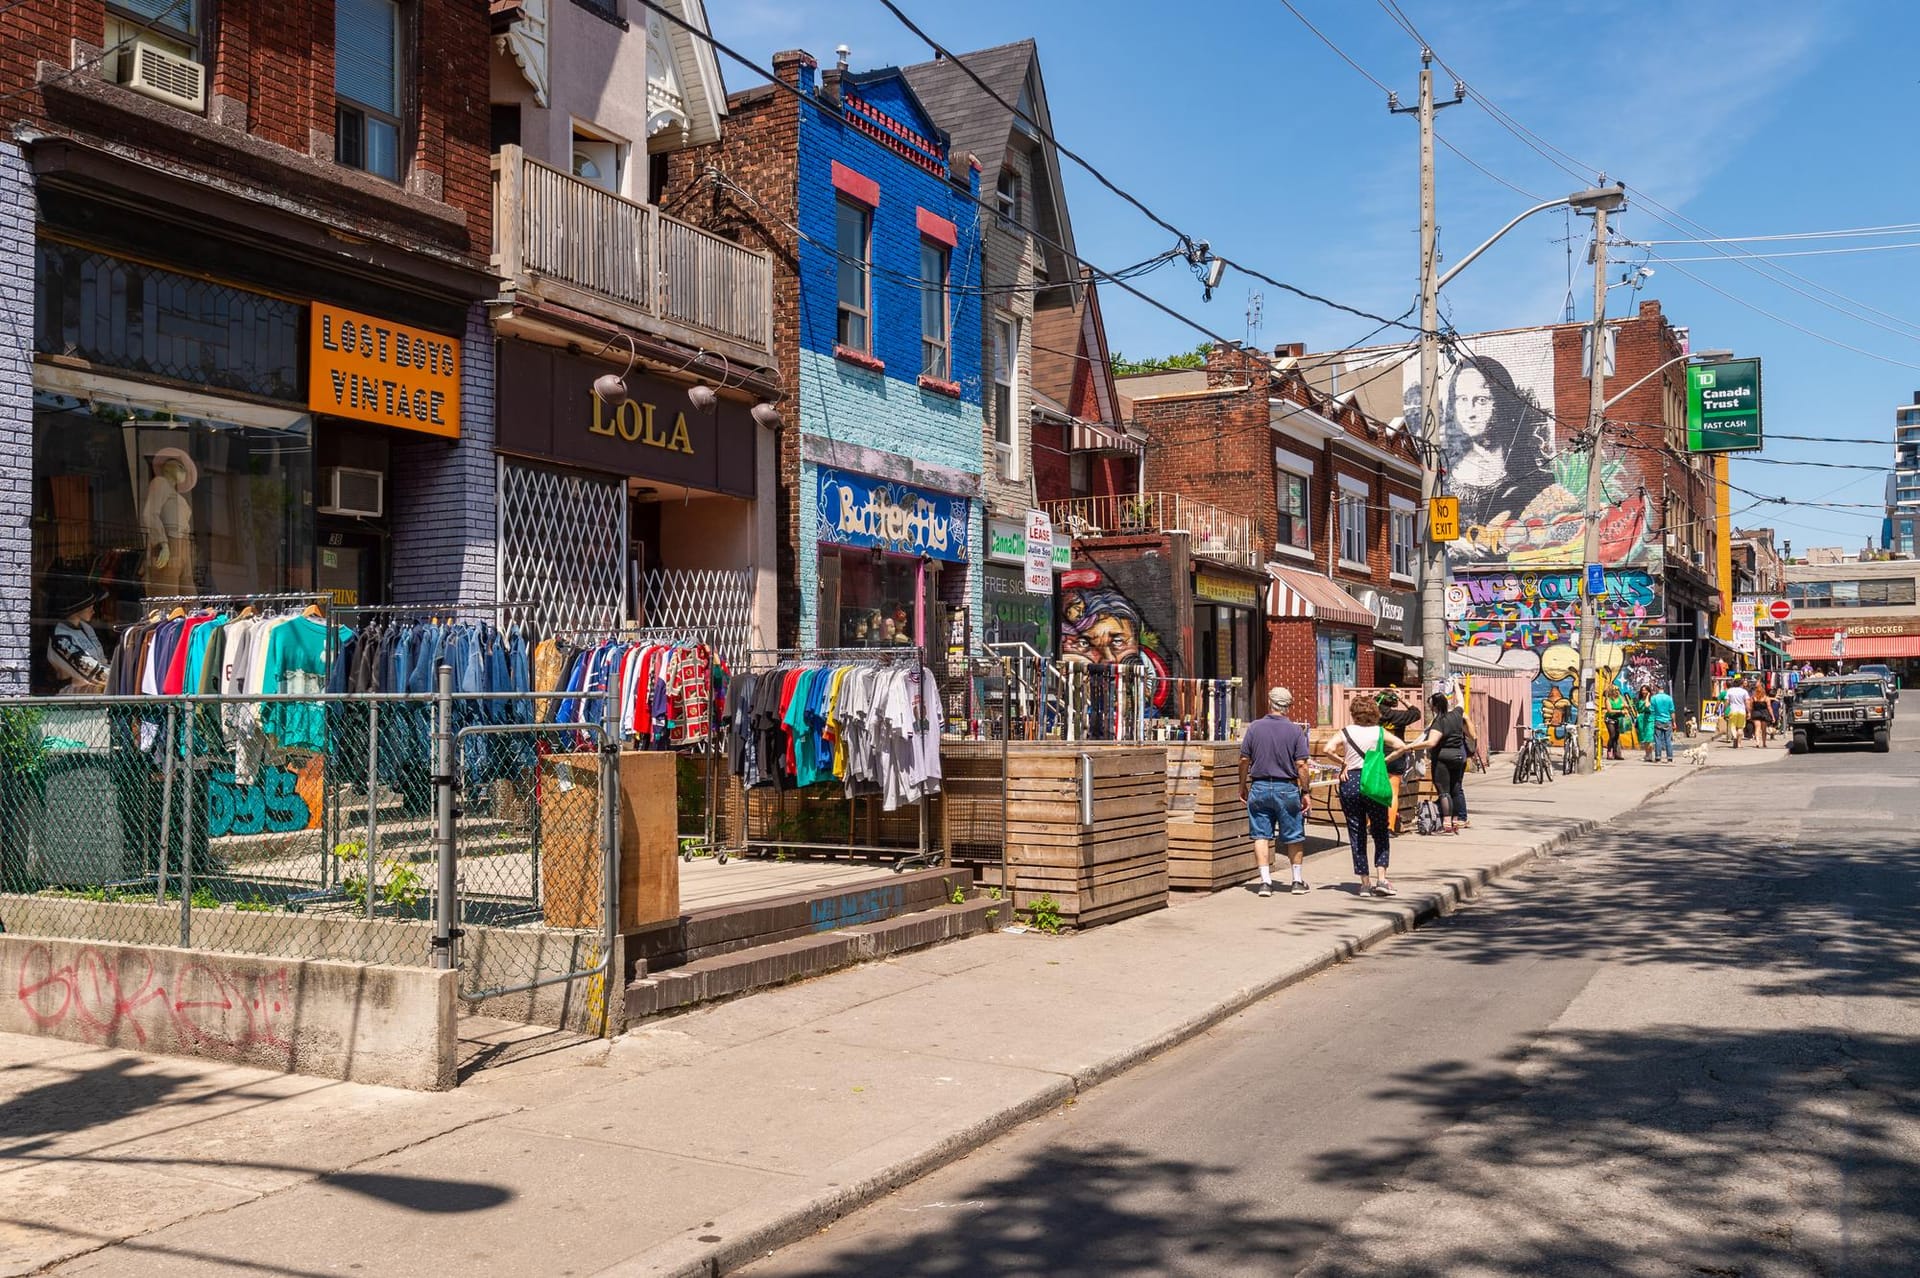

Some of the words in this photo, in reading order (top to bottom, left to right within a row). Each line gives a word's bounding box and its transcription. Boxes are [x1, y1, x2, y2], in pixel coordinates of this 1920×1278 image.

[323, 314, 391, 363] LOST
[396, 332, 454, 377] BOYS
[1697, 373, 1714, 385] TD
[331, 369, 445, 425] VINTAGE
[1703, 387, 1751, 399] Canada
[1703, 399, 1739, 410] Trust
[589, 388, 694, 454] LOLA
[1703, 422, 1722, 430] FAST
[1724, 420, 1746, 428] CASH
[1437, 505, 1449, 518] NO
[836, 486, 950, 552] Butterfly
[1029, 527, 1050, 542] LEASE
[1436, 522, 1453, 535] EXIT
[984, 575, 1008, 594] FREE
[1848, 626, 1868, 634] MEAT
[1871, 626, 1904, 634] LOCKER
